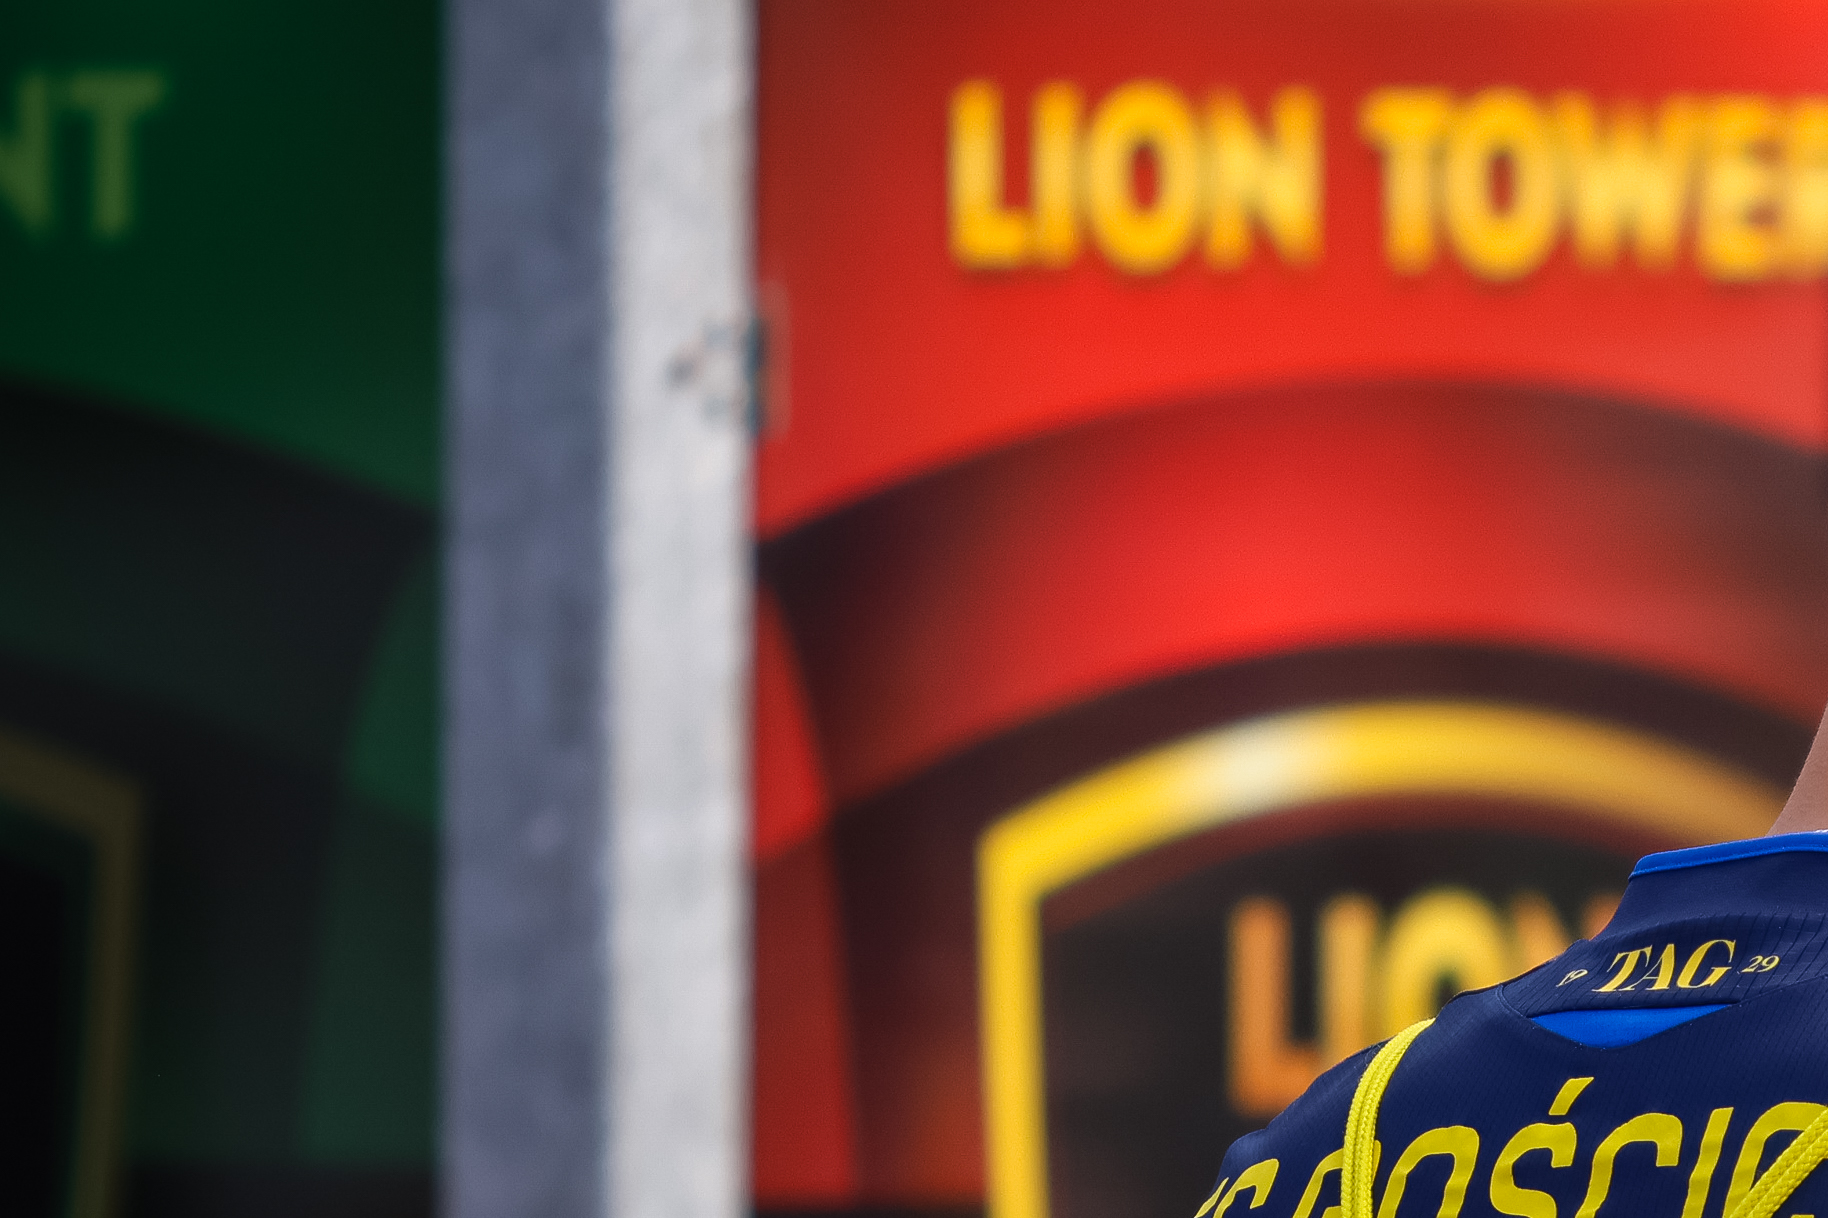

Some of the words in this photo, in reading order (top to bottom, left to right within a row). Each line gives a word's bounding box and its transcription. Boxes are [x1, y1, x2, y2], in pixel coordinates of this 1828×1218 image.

[948, 79, 1325, 275] LION
[1591, 939, 1736, 992] TAG
[1741, 955, 1780, 973] 29
